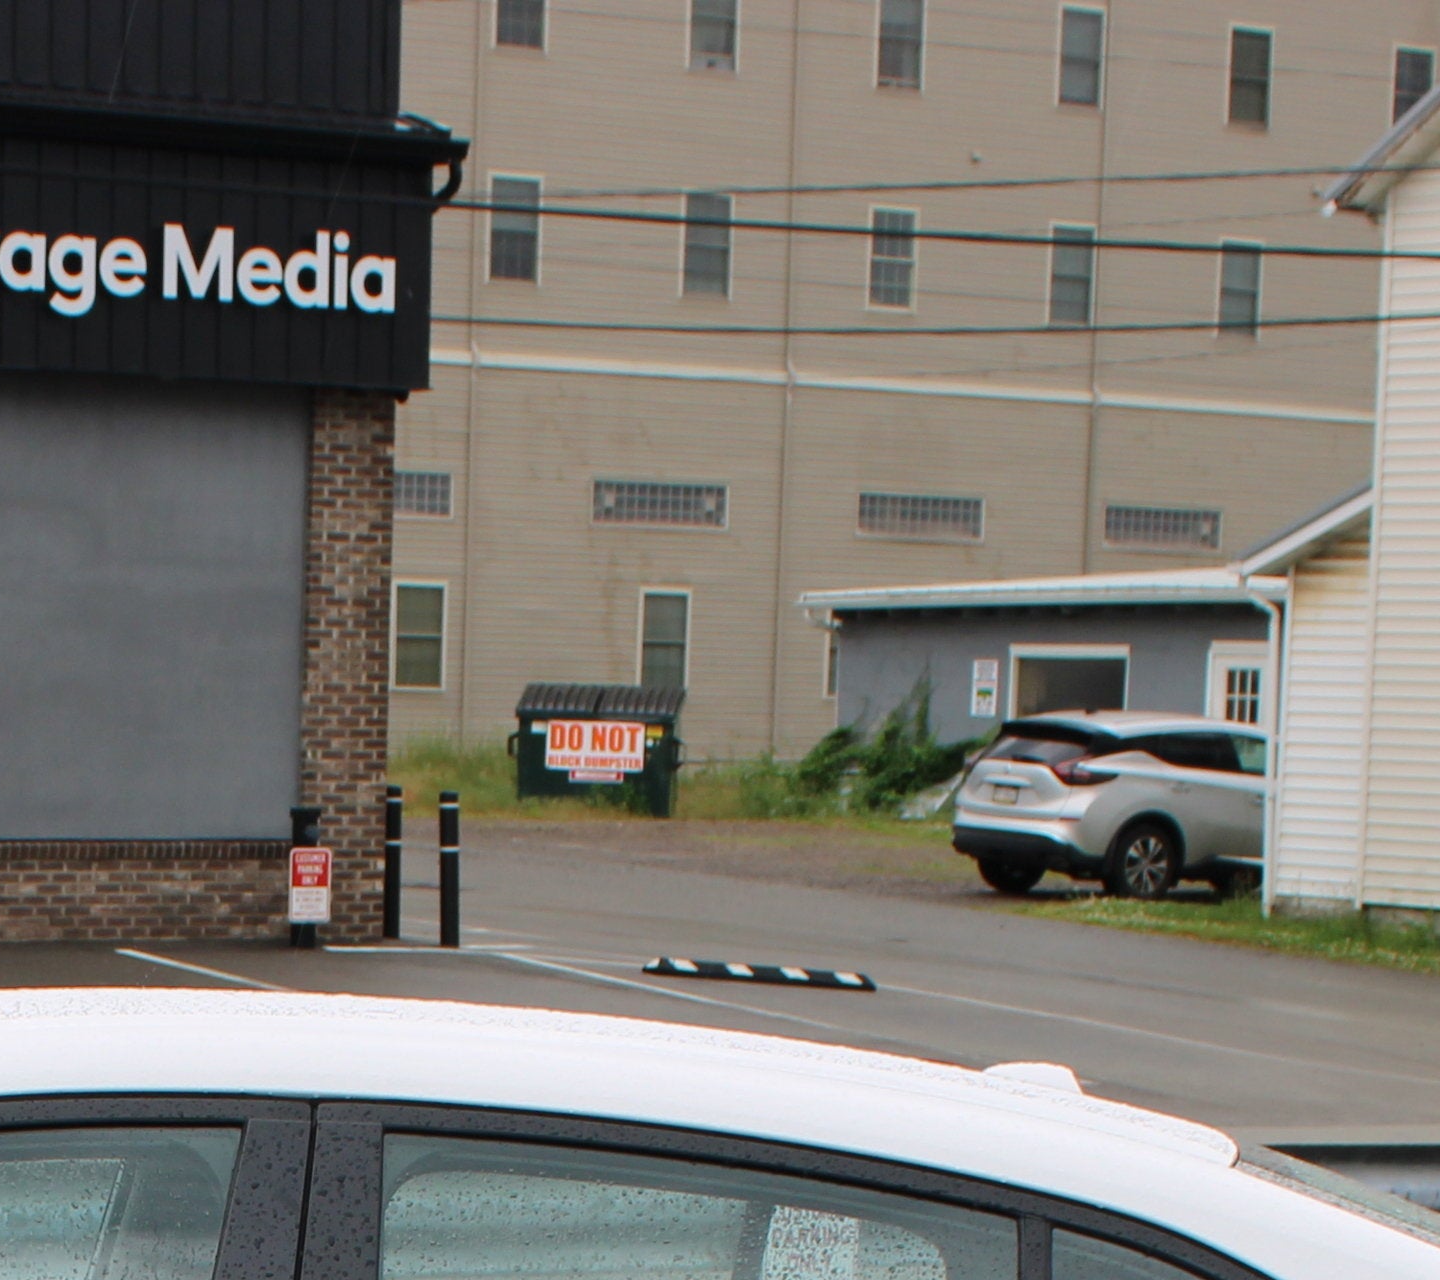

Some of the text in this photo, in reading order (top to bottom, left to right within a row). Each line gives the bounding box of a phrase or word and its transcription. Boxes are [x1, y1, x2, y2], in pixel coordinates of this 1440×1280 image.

[162, 223, 397, 313] Media
[549, 723, 641, 753] DO NOT
[771, 1226, 858, 1247] PARKING
[787, 1253, 833, 1273] ONLY
